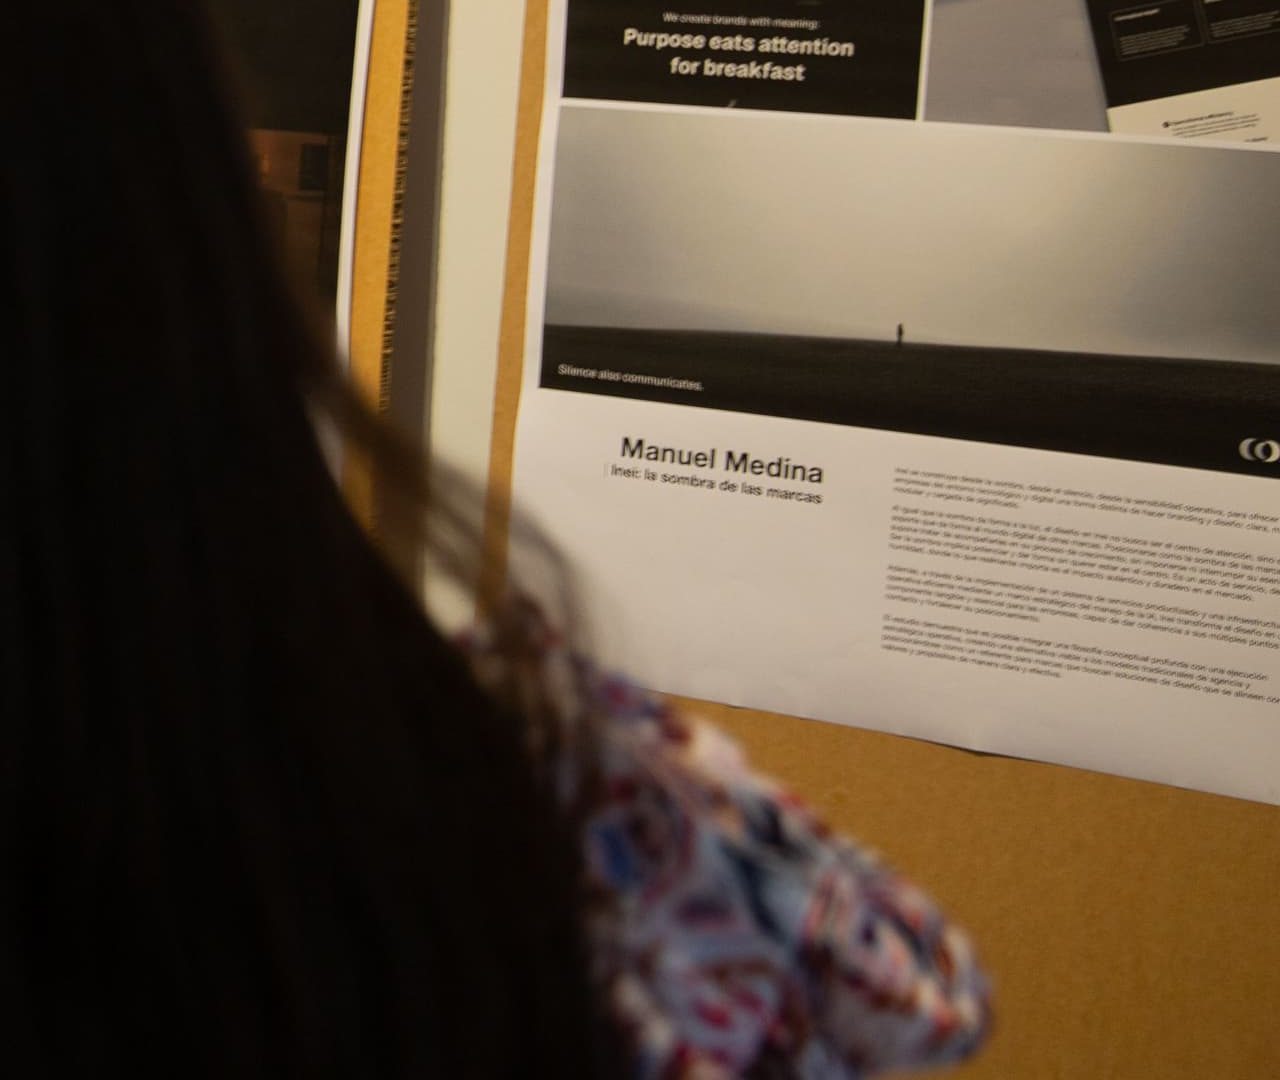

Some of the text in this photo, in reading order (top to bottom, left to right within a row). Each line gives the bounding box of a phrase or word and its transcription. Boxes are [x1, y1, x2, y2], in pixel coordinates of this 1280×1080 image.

[662, 11, 679, 22] We
[749, 16, 771, 27] with
[623, 27, 855, 57] Purpose eats attention
[670, 57, 807, 81] for breakfast
[557, 363, 704, 391] Silence also communicates.
[620, 436, 824, 483] Manuel Medina
[610, 464, 824, 505] Inei: la sombra de las marcas
